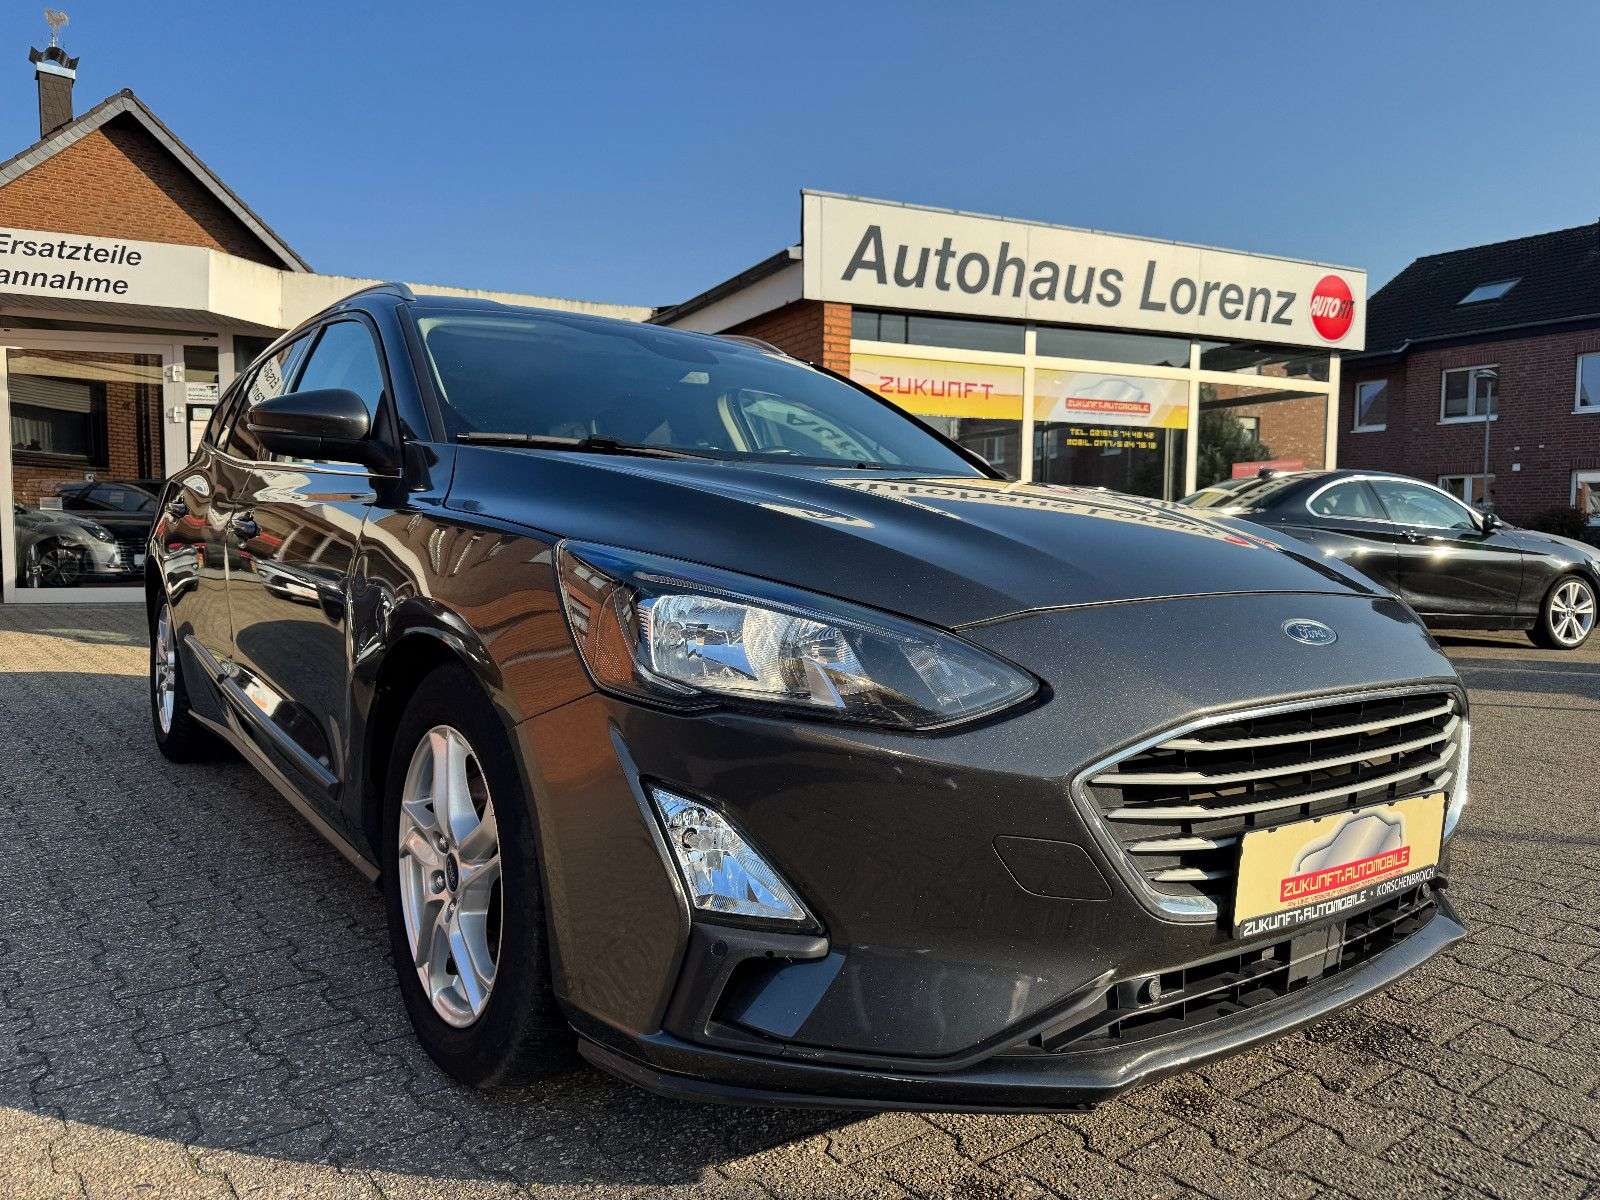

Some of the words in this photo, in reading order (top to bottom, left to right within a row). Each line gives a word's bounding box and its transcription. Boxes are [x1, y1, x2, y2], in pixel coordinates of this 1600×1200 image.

[0, 233, 142, 266] Ersatzteile
[841, 224, 1124, 308] Autohaus
[1139, 260, 1298, 327] Lorenz
[880, 376, 994, 400] ZUKUNFT
[1376, 867, 1435, 897] KORSCHENBROICH
